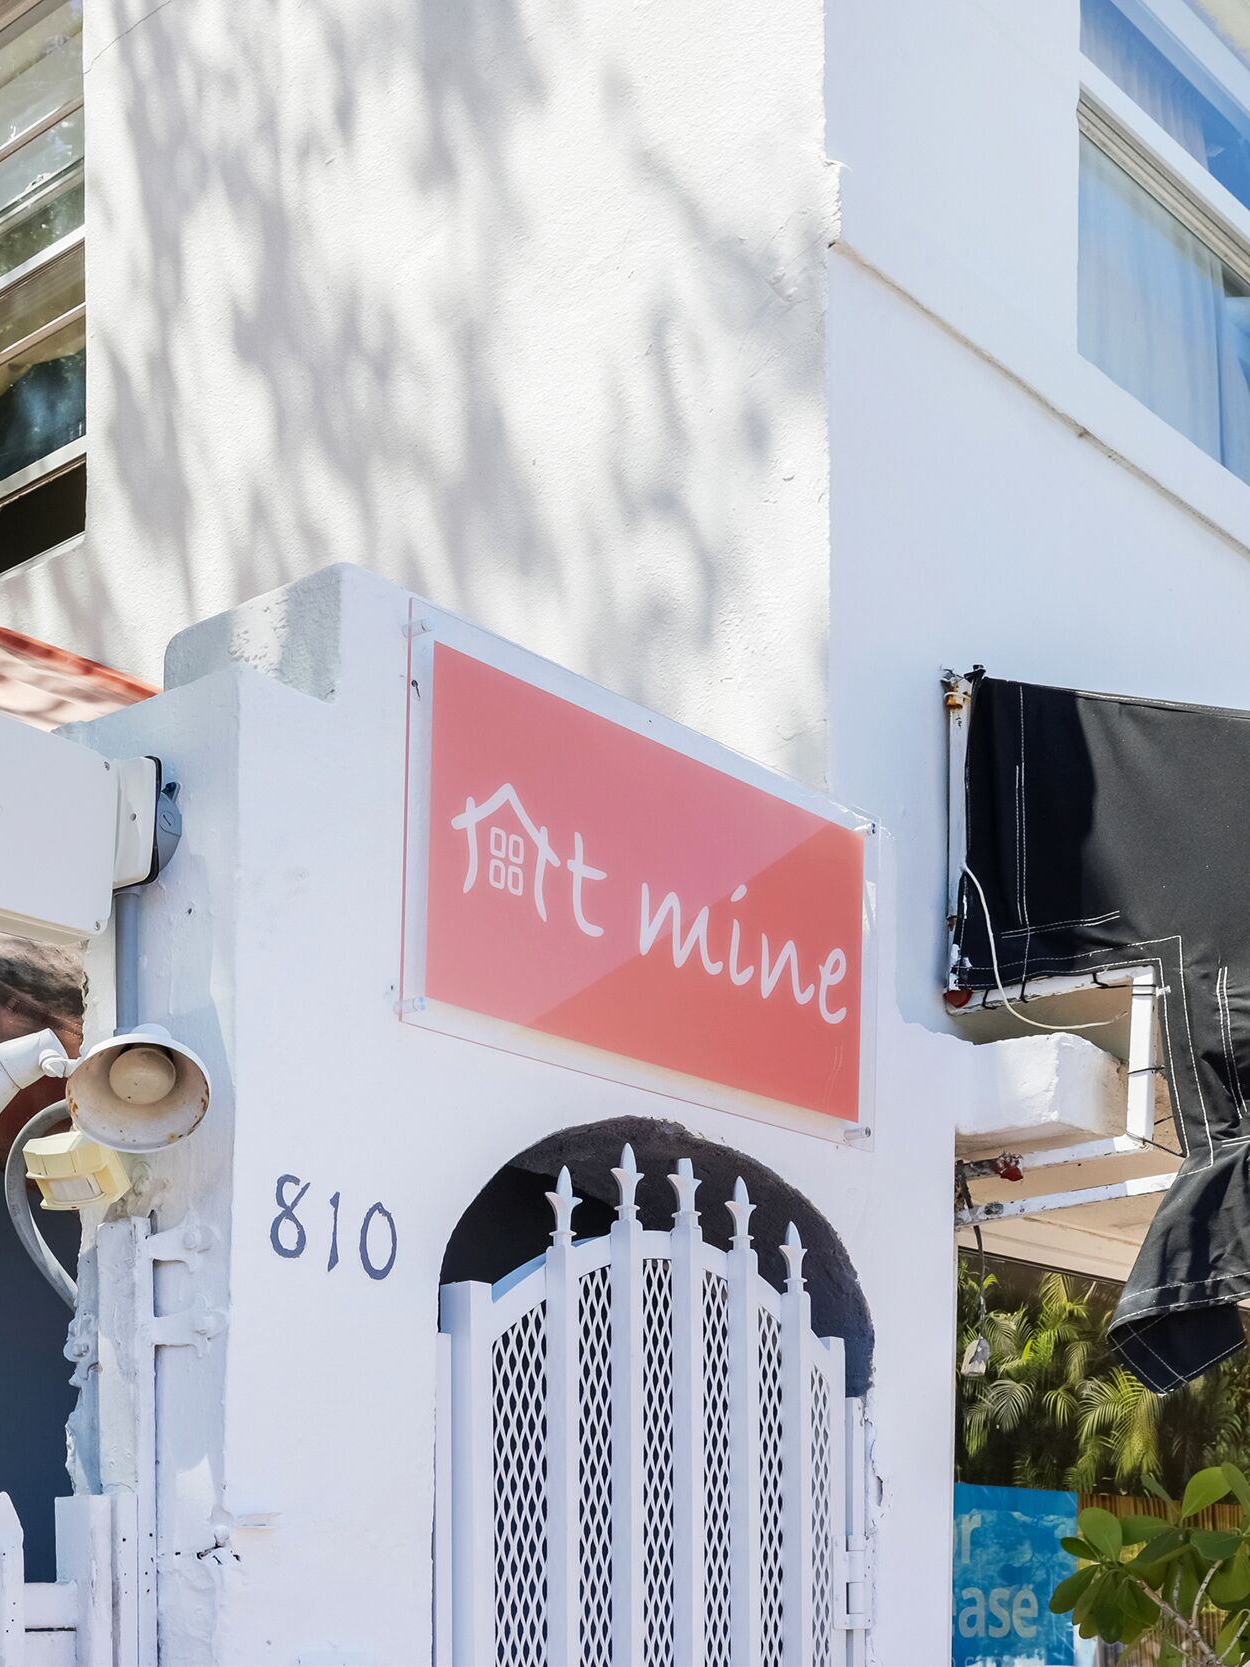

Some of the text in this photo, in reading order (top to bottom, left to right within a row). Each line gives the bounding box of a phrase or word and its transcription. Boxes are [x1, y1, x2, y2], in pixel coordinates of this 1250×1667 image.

[639, 882, 848, 1025] mine
[269, 1173, 398, 1281] 810
[953, 1508, 982, 1564] r
[952, 1586, 1039, 1639] ase
